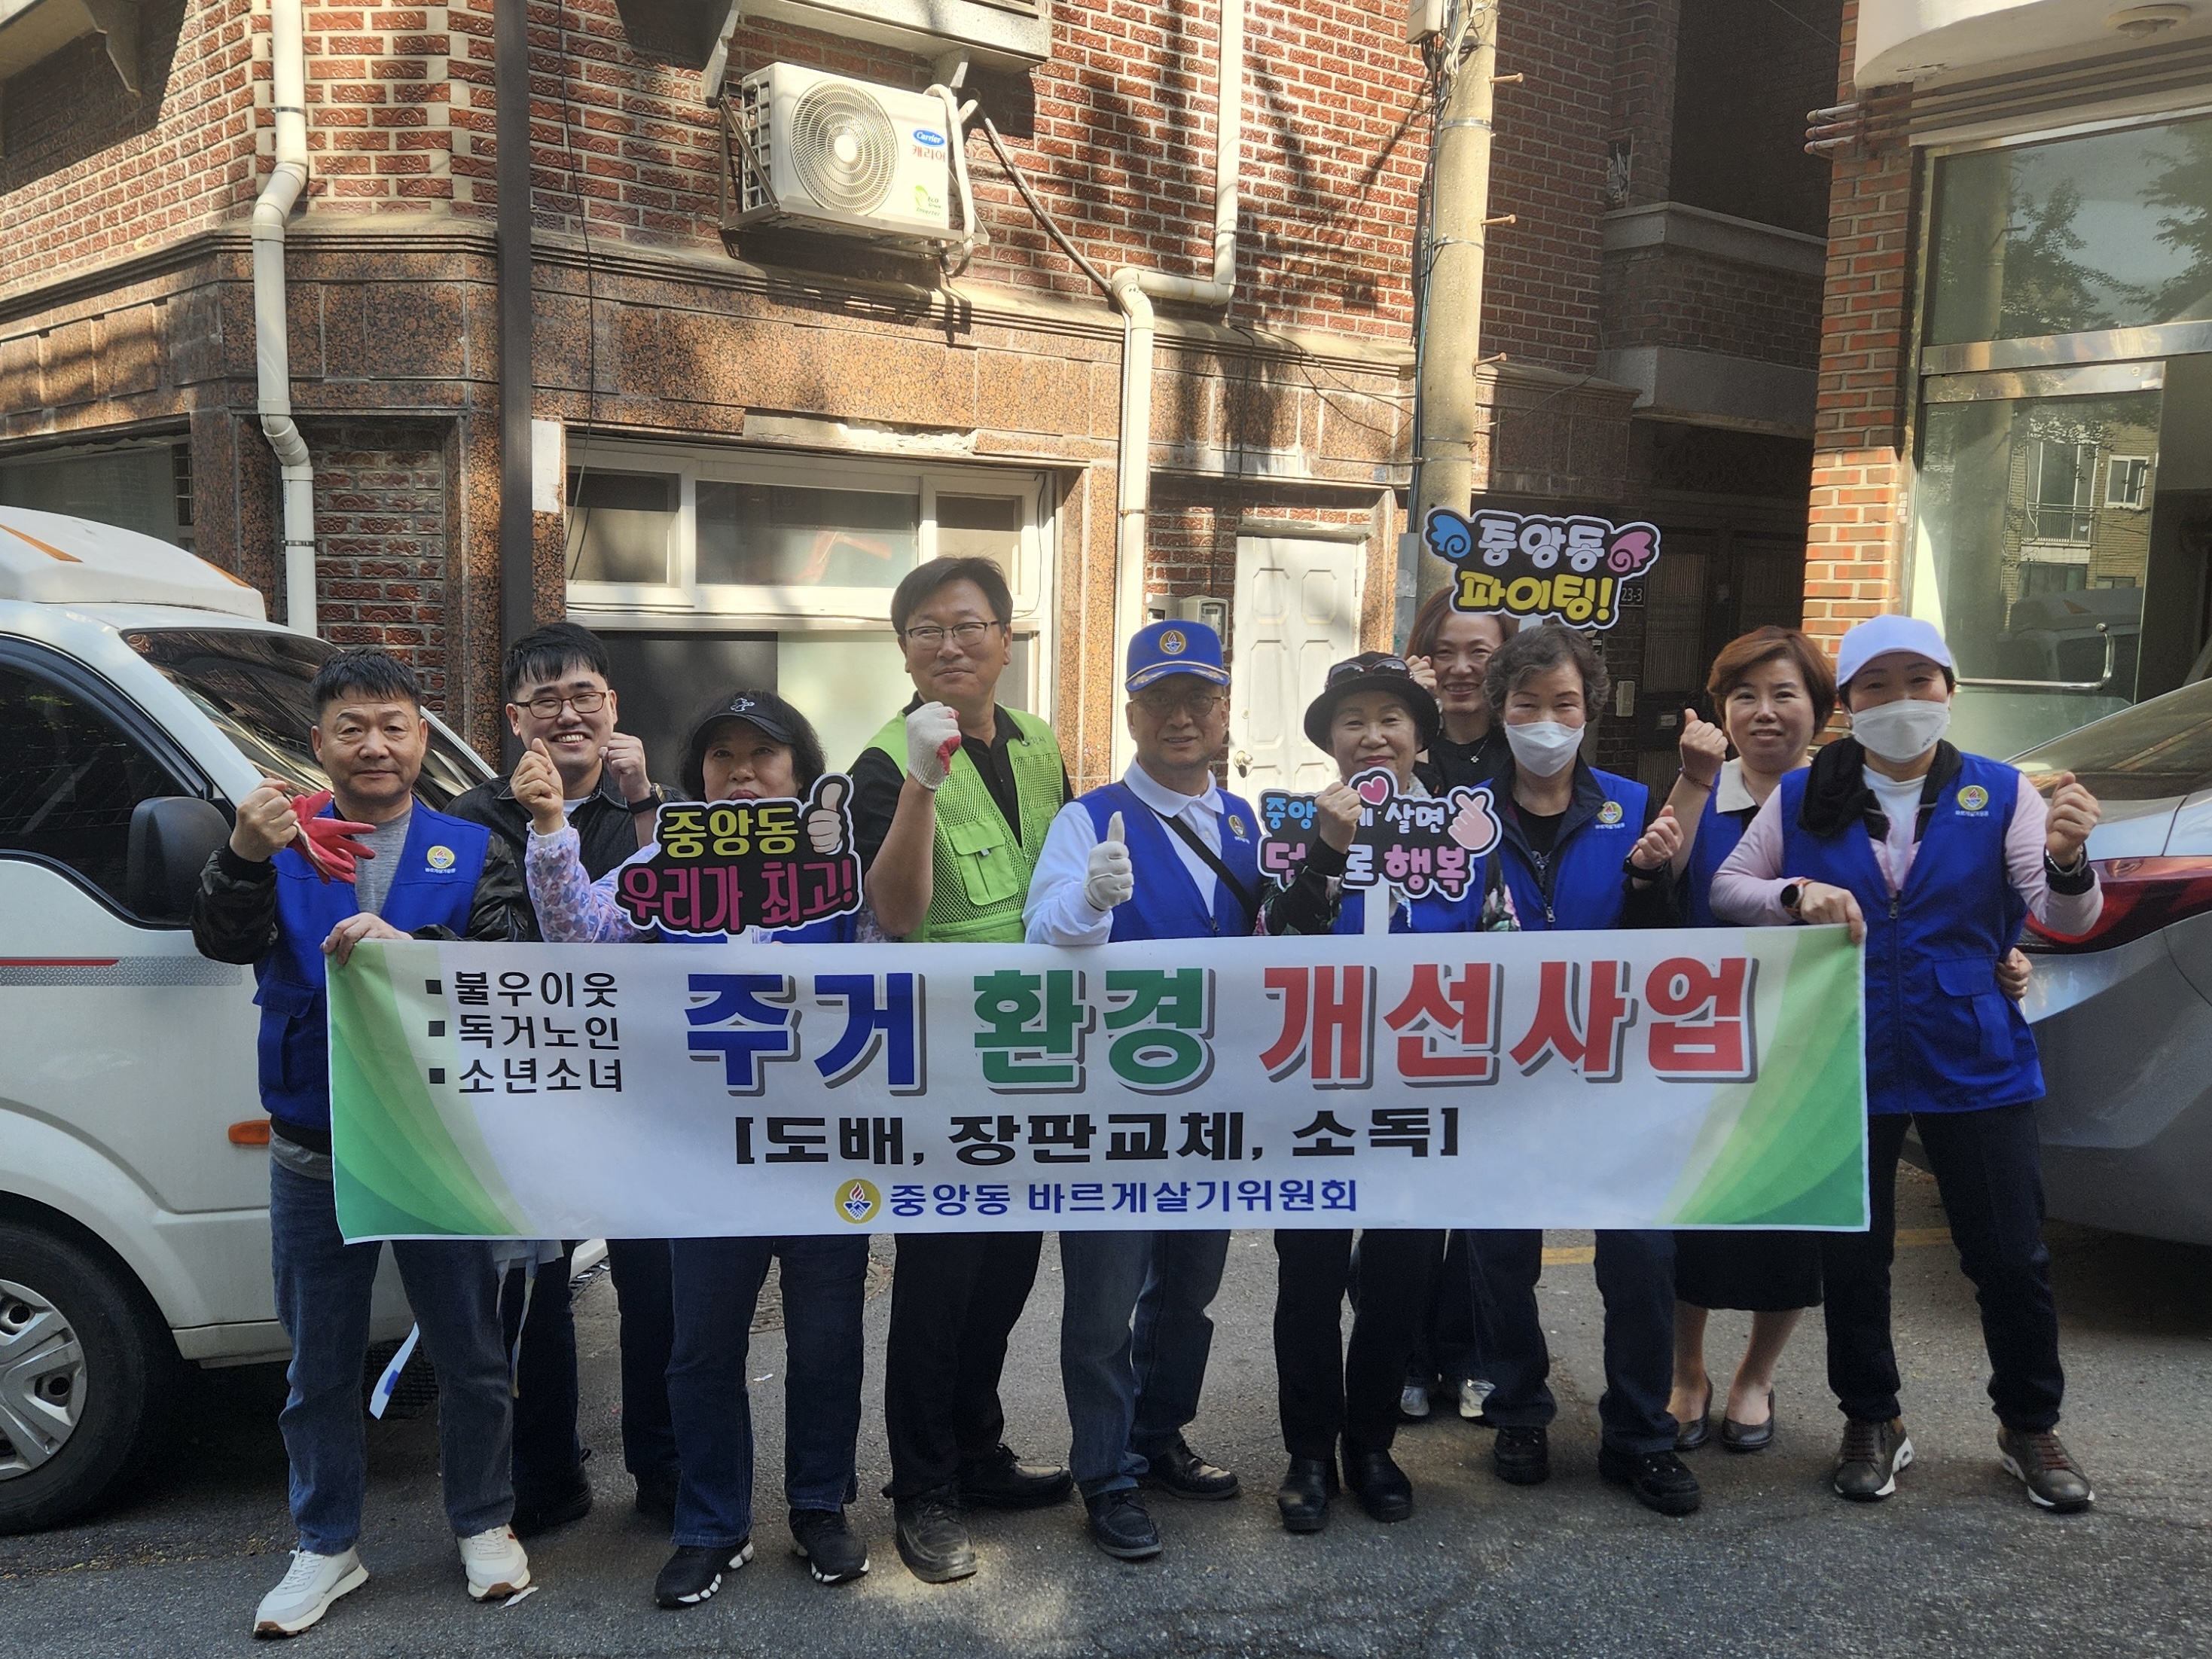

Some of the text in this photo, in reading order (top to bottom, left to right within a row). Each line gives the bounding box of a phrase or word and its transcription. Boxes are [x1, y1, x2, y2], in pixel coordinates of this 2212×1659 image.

[912, 145, 946, 162] 캐리어
[916, 131, 941, 144] Carrier
[1478, 518, 1605, 572] 중앙동
[1458, 571, 1613, 621] 파이팅!
[1621, 587, 1643, 602] 23-3
[662, 807, 798, 858] 중앙동
[1384, 802, 1445, 834] 살면
[1384, 843, 1466, 893] 행복
[621, 859, 852, 931] 우리가 최고!
[454, 971, 618, 1008] 불우이웃
[459, 1014, 620, 1051] 독거노인
[685, 956, 1758, 1096] 주거 환경 개선사업
[458, 1057, 622, 1094] 소년소녀
[736, 1107, 1460, 1166] [도배, 장판교체, 소독]
[889, 1176, 1357, 1217] 중앙동 바르게살기위원회
